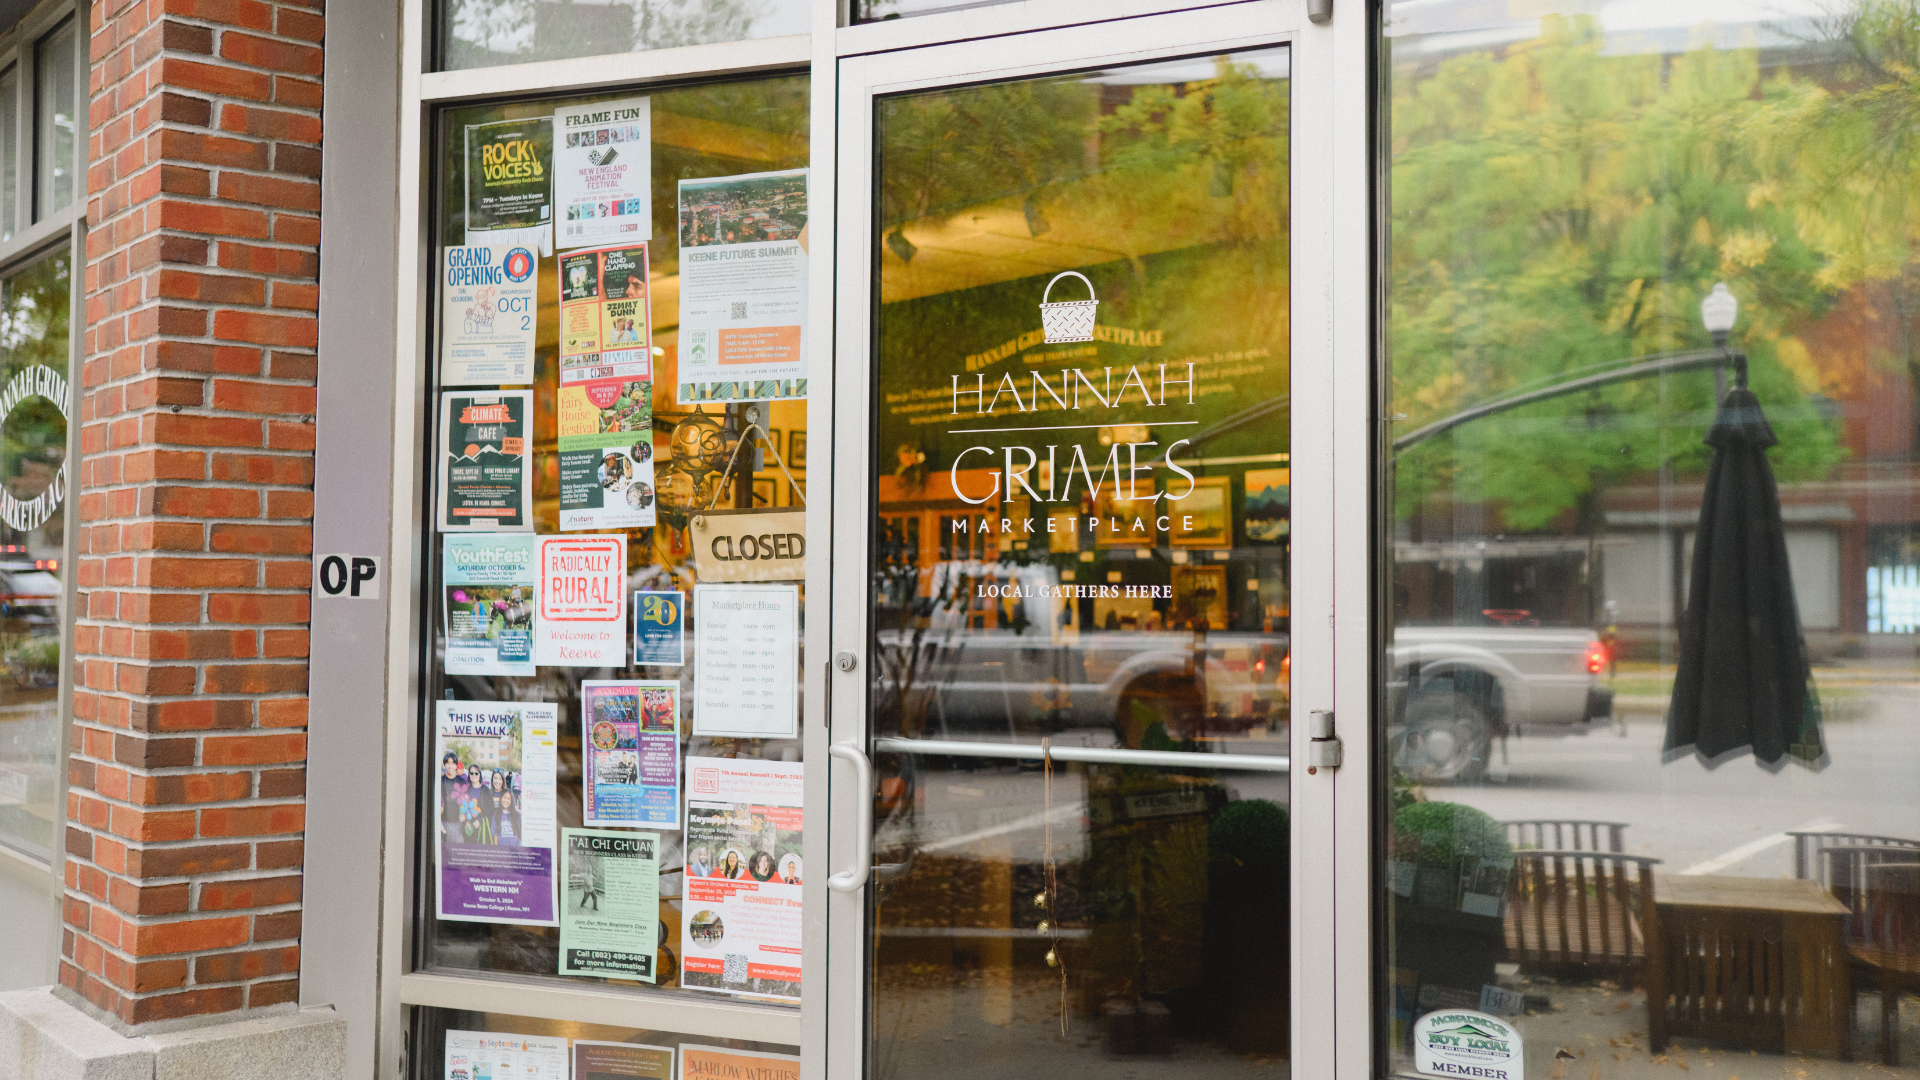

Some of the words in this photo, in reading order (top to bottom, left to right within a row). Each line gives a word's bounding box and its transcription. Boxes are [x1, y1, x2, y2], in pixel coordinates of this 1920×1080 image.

[566, 112, 611, 126] FRAME
[614, 108, 640, 120] FUN
[482, 140, 530, 166] ROCK
[484, 162, 531, 180] VOICES
[579, 168, 594, 176] NEW
[596, 164, 627, 174] ENGLAND
[584, 172, 622, 182] ANIMATION
[588, 180, 619, 190] FESTIVAL
[499, 196, 522, 204] Tuesdays
[448, 247, 492, 267] GRAND
[688, 250, 717, 263] KEENE
[720, 248, 756, 261] FUTURE
[758, 246, 798, 258] SUMMIT
[604, 262, 636, 271] CLAPPING
[448, 266, 502, 286] OPENING
[498, 297, 531, 312] OCT
[607, 300, 638, 310] JIMMY
[610, 308, 635, 317] DUNN
[520, 316, 530, 330] 2
[591, 386, 616, 394] SEPTEMBER
[952, 362, 1196, 415] HANNAH
[562, 398, 583, 410] Fairy
[471, 409, 502, 421] CLIMATE
[562, 410, 590, 422] House
[478, 427, 496, 440] CAFE
[562, 421, 596, 436] Festival
[951, 438, 1195, 504] GRIMES
[952, 516, 1194, 534] MARKETPLACE
[712, 533, 806, 561] CLOSED
[450, 548, 528, 564] YouthFest
[552, 556, 610, 572] RADICALLY
[320, 555, 376, 596] OP
[552, 576, 613, 604] RURAL
[978, 585, 1034, 598] LOCAL
[1040, 585, 1120, 598] GATHERS
[1125, 585, 1173, 598] HERE
[643, 595, 677, 626] 20
[712, 601, 756, 610] Marketplace
[758, 601, 780, 609] Hours
[551, 630, 598, 640] Welcome
[599, 632, 612, 640] to
[559, 646, 603, 659] Keene
[706, 674, 731, 682] Thursday
[600, 687, 633, 696] COLONIAL
[449, 713, 472, 723] THIS
[476, 714, 485, 723] IS
[488, 714, 515, 724] WHY
[454, 726, 472, 735] WE
[475, 726, 509, 736] WALK.
[696, 779, 716, 789] RURAL
[690, 814, 726, 825] Keynote
[726, 816, 751, 826] Panel
[569, 837, 589, 848] T'AI
[591, 839, 610, 850] CHI
[613, 840, 654, 852] CH'UAN
[474, 885, 507, 894] WESTERN
[508, 886, 519, 894] NH
[743, 895, 784, 906] CONNECT
[591, 951, 612, 960] (802)
[613, 952, 646, 962] 490-6405
[605, 960, 646, 970] information
[1430, 1015, 1510, 1037] MONADNOCK
[488, 1039, 521, 1049] September
[1428, 1033, 1460, 1046] BUY
[1467, 1038, 1510, 1052] LOCAL
[693, 1060, 740, 1079] MARLOW
[1432, 1061, 1508, 1080] MEMBER
